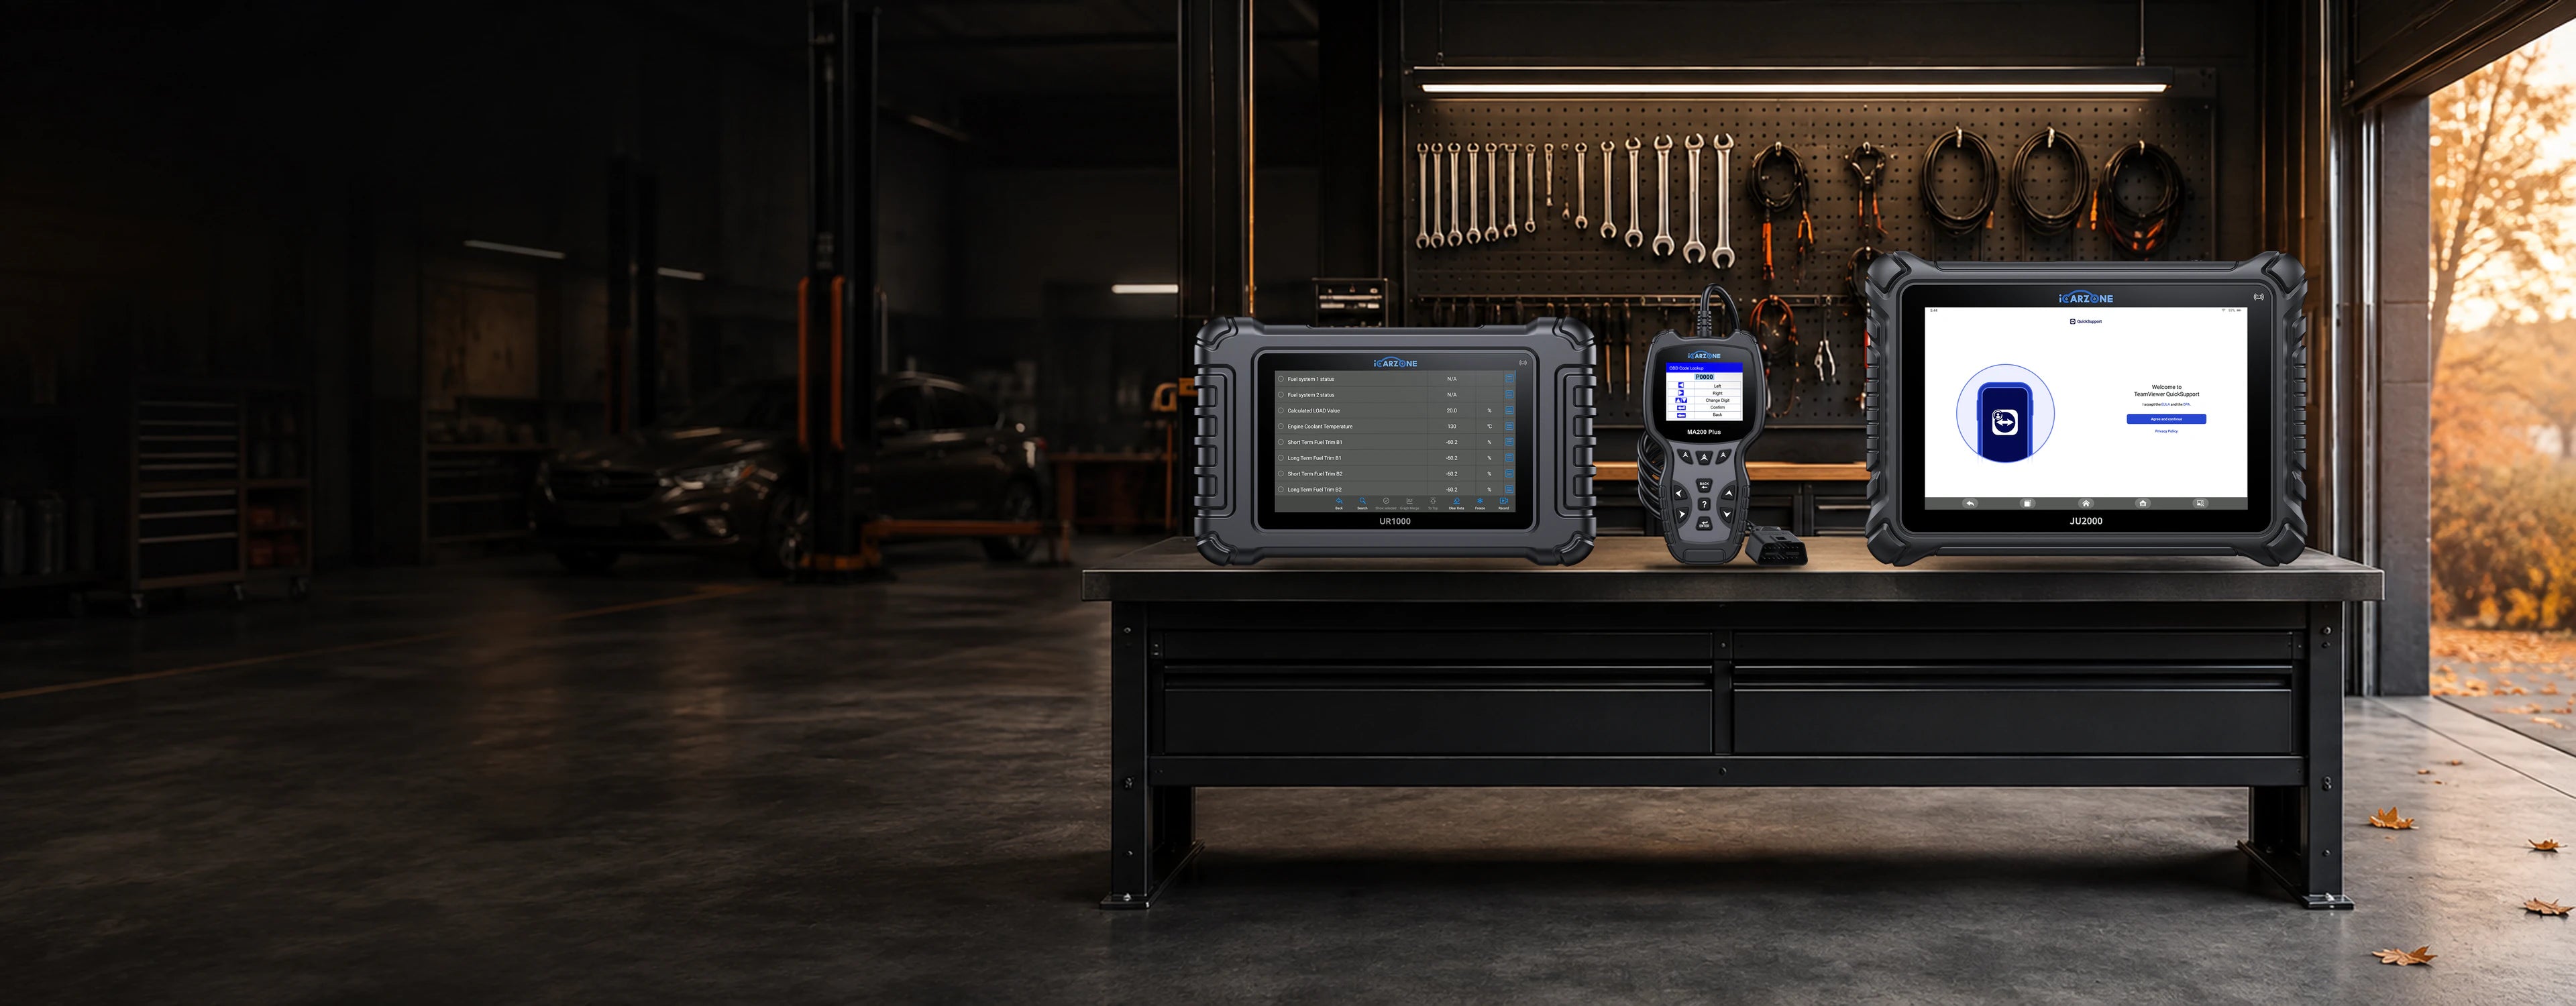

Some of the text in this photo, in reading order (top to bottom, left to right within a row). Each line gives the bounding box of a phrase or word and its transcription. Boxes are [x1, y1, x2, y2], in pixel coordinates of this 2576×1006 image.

[2059, 294, 2113, 304] iCARZONE
[1373, 359, 1417, 368] iCARZONE
[2070, 517, 2102, 525] JU2000
